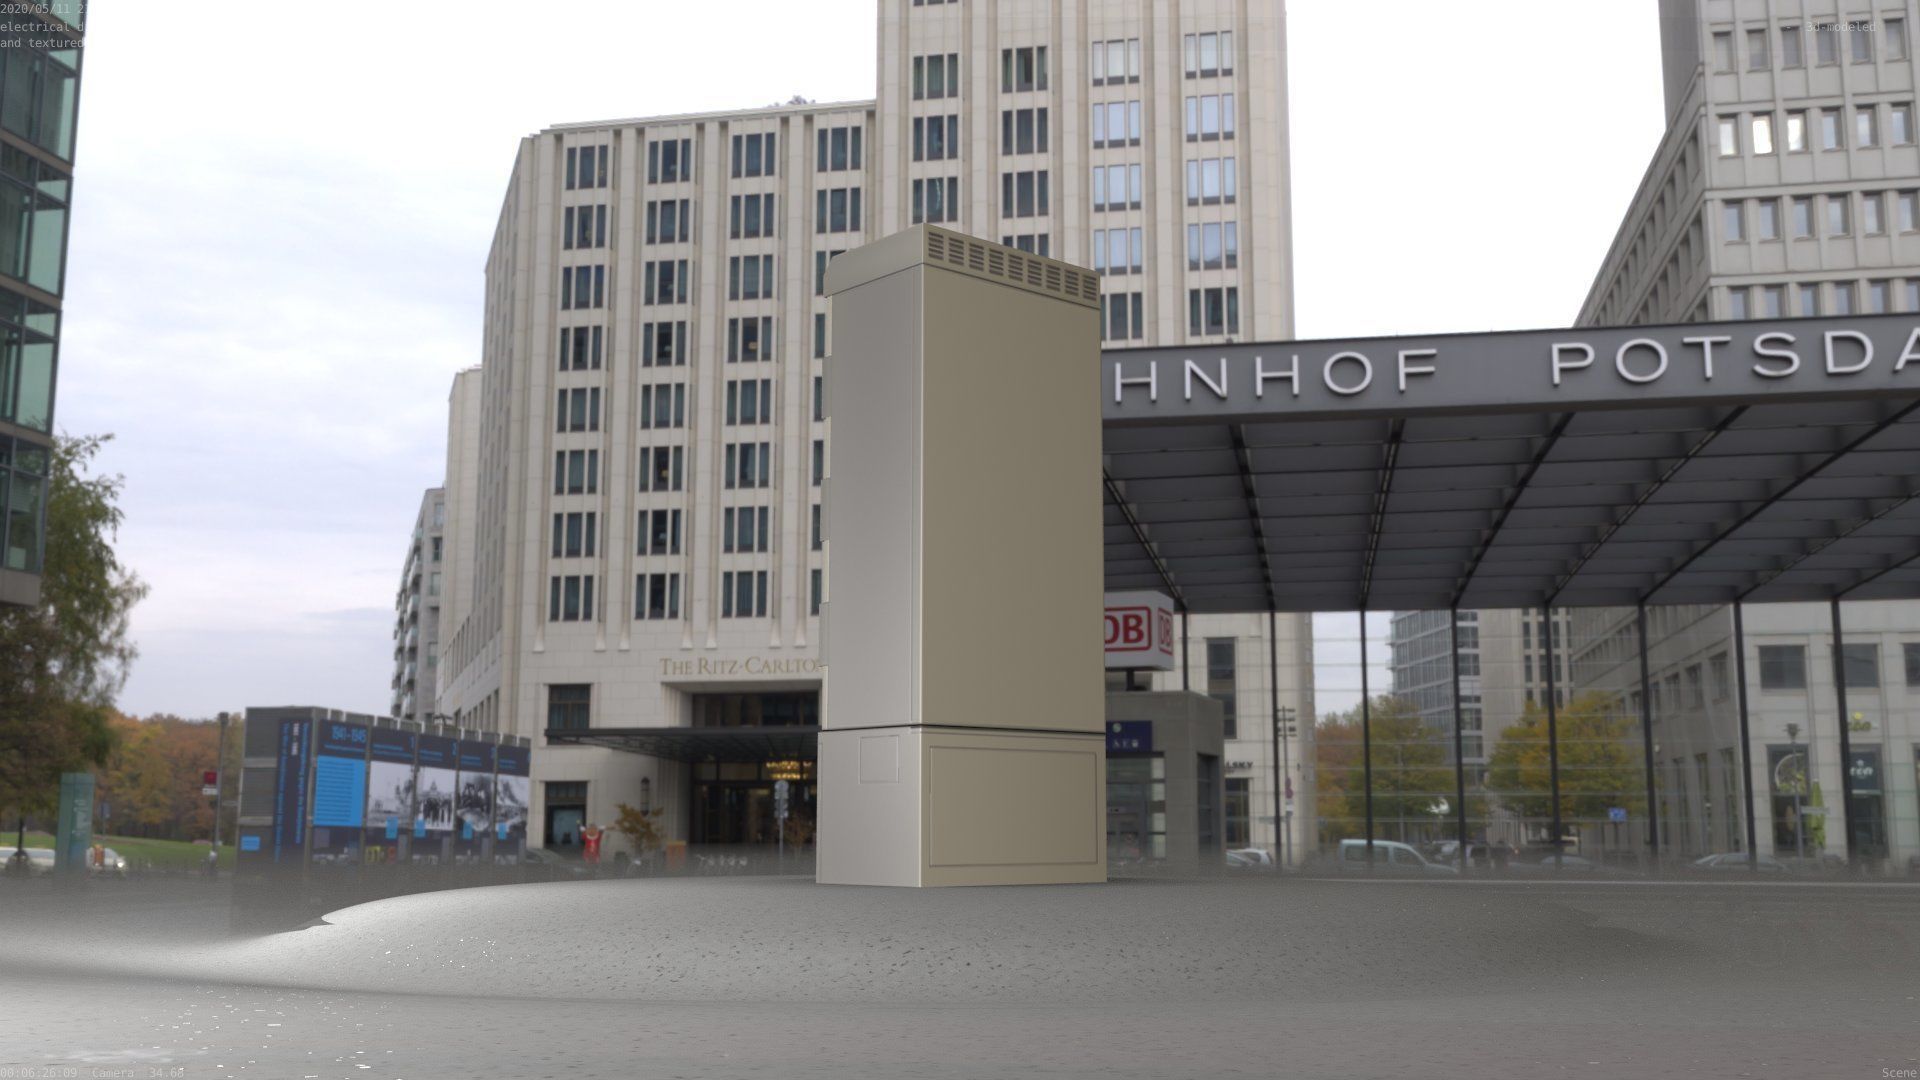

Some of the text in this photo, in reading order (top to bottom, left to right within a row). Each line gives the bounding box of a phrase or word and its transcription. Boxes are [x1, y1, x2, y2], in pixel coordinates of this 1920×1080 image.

[1115, 349, 1437, 403] HNHOF
[1104, 613, 1145, 645] DB
[660, 658, 692, 676] THE
[1223, 760, 1253, 769] LSKY
